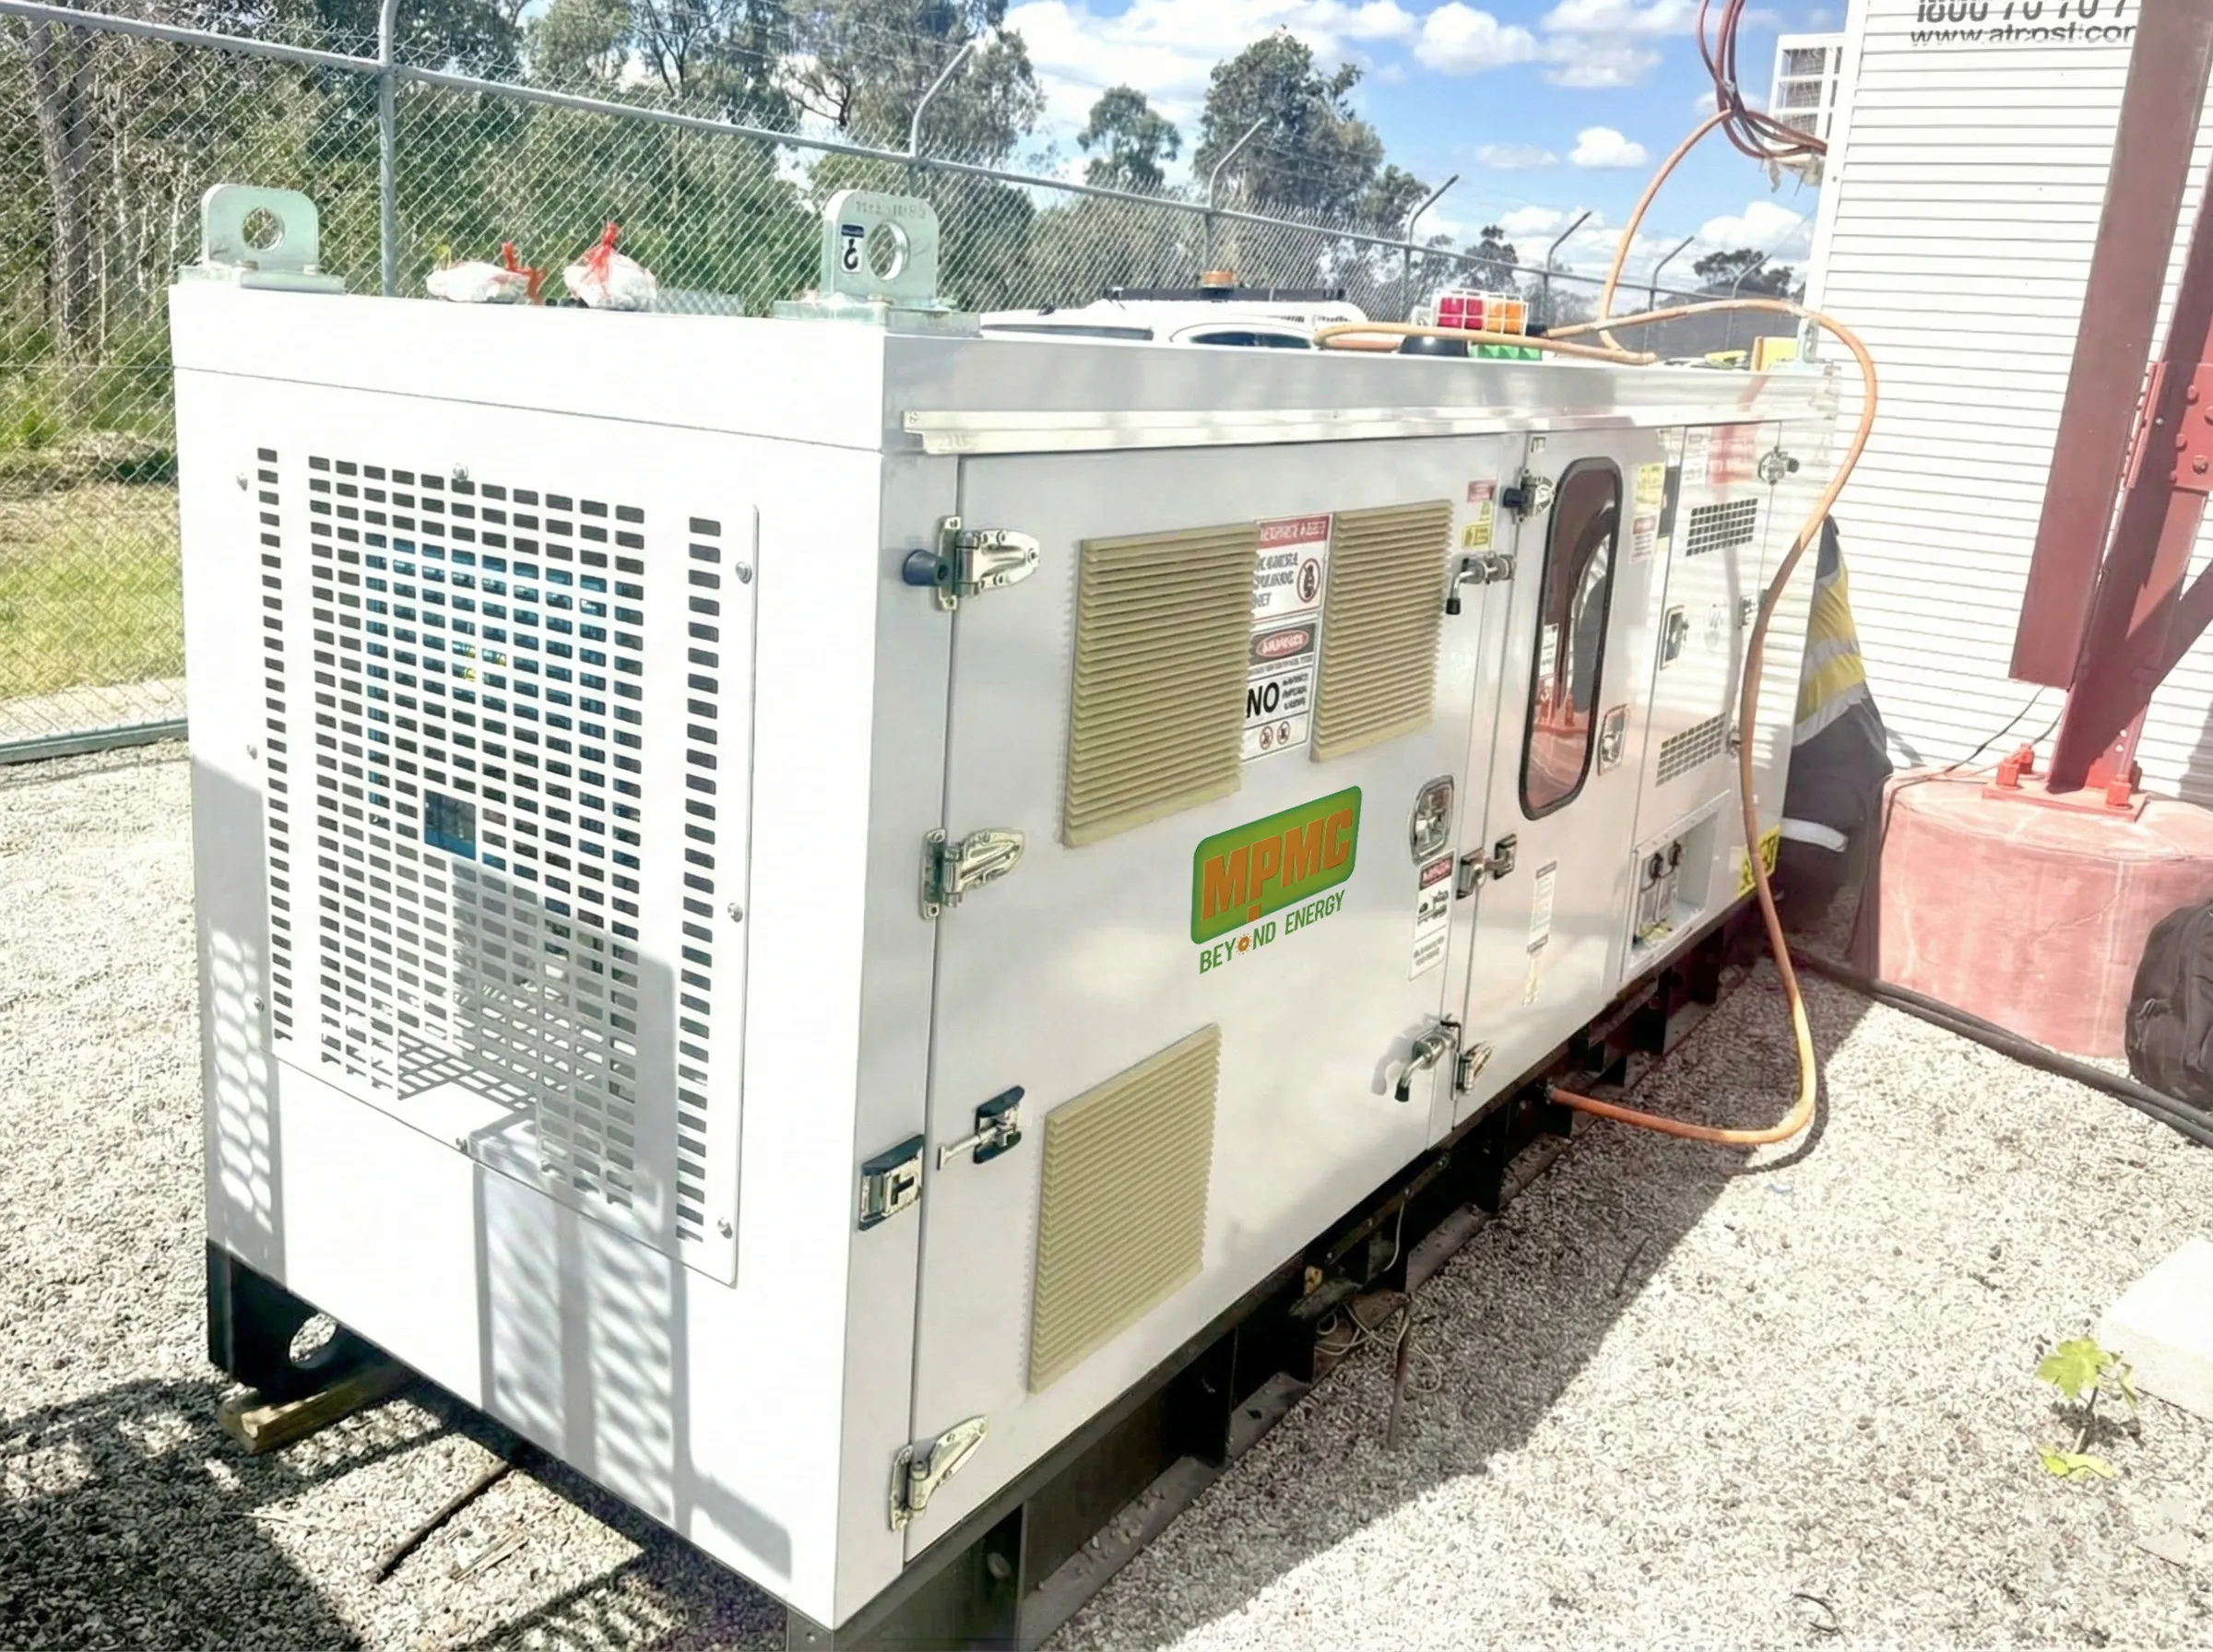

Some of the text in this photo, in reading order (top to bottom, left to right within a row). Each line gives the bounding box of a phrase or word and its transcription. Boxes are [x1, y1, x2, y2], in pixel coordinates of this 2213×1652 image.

[1247, 681, 1280, 719] NO
[1201, 808, 1353, 923] MPMC
[1284, 890, 1345, 936] ENERGY
